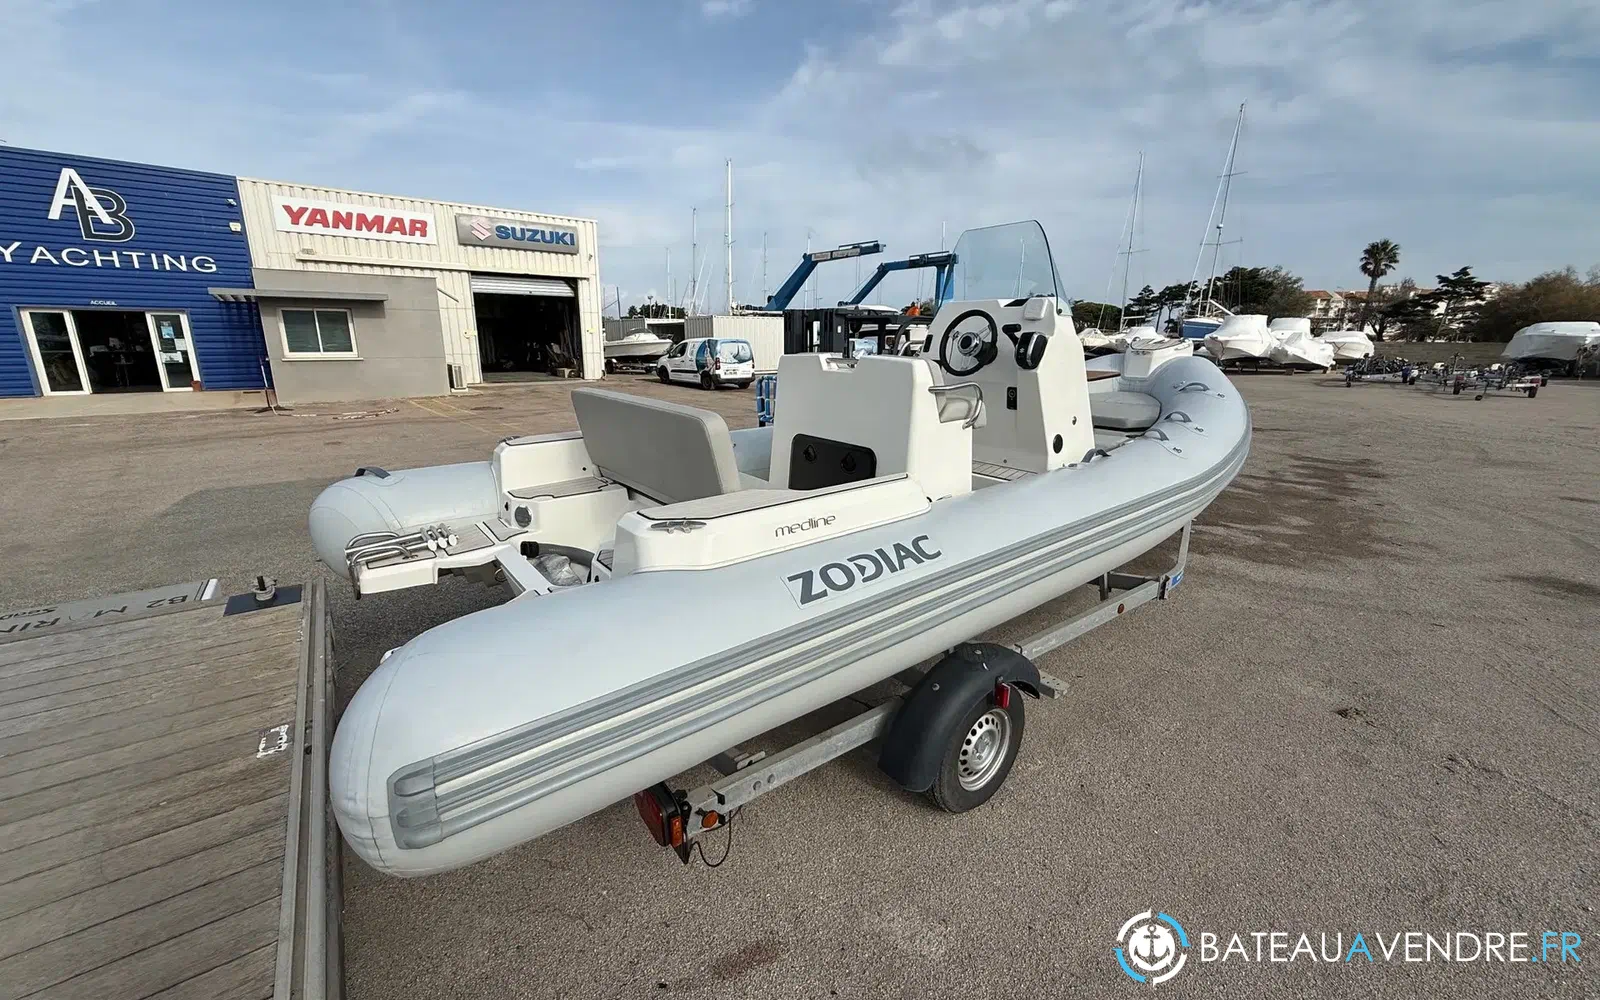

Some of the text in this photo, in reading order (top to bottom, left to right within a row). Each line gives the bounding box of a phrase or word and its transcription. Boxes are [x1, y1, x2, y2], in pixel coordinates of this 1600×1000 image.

[282, 204, 428, 238] YANMAR
[495, 224, 576, 247] SUZUKI
[0, 241, 217, 273] YACHTING
[775, 515, 836, 537] medline
[787, 534, 942, 605] ZODIAC
